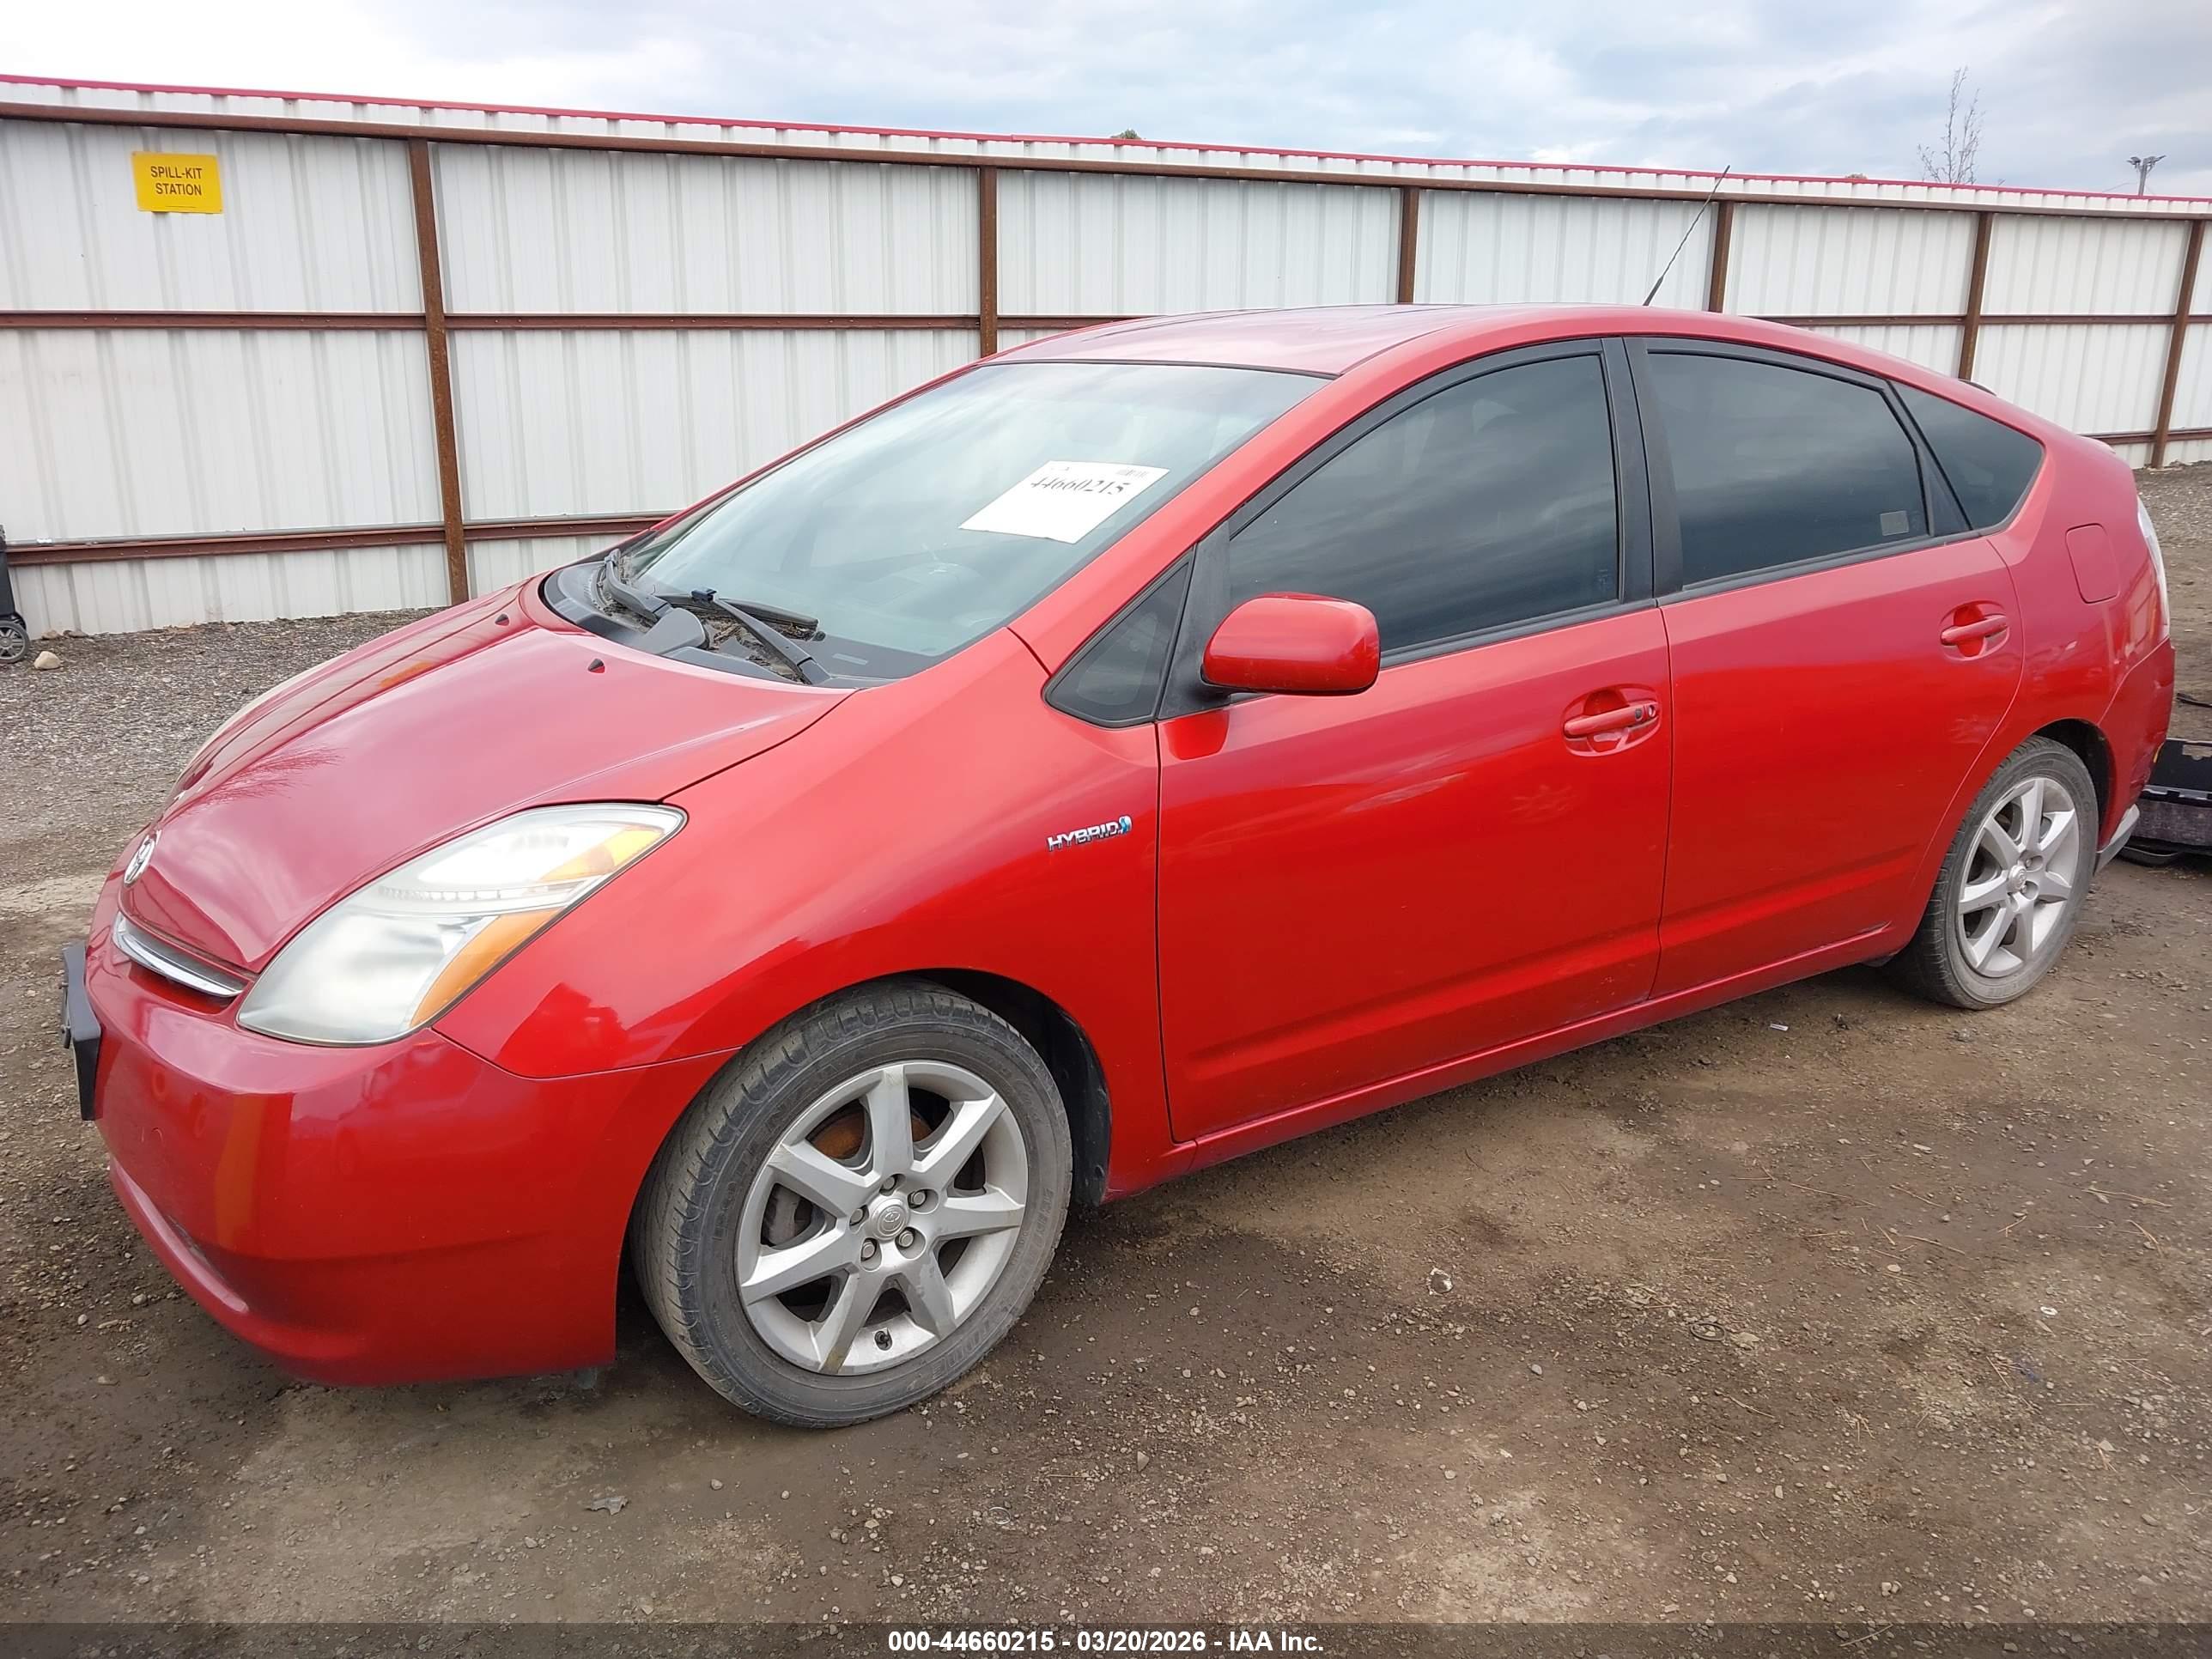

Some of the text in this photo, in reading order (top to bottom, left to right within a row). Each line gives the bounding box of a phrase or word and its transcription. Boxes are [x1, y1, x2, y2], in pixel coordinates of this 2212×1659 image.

[150, 165, 202, 179] SPILL-KIT
[155, 183, 202, 196] STATION
[1030, 477, 1132, 495] 44660215
[1047, 821, 1120, 851] HYBRID
